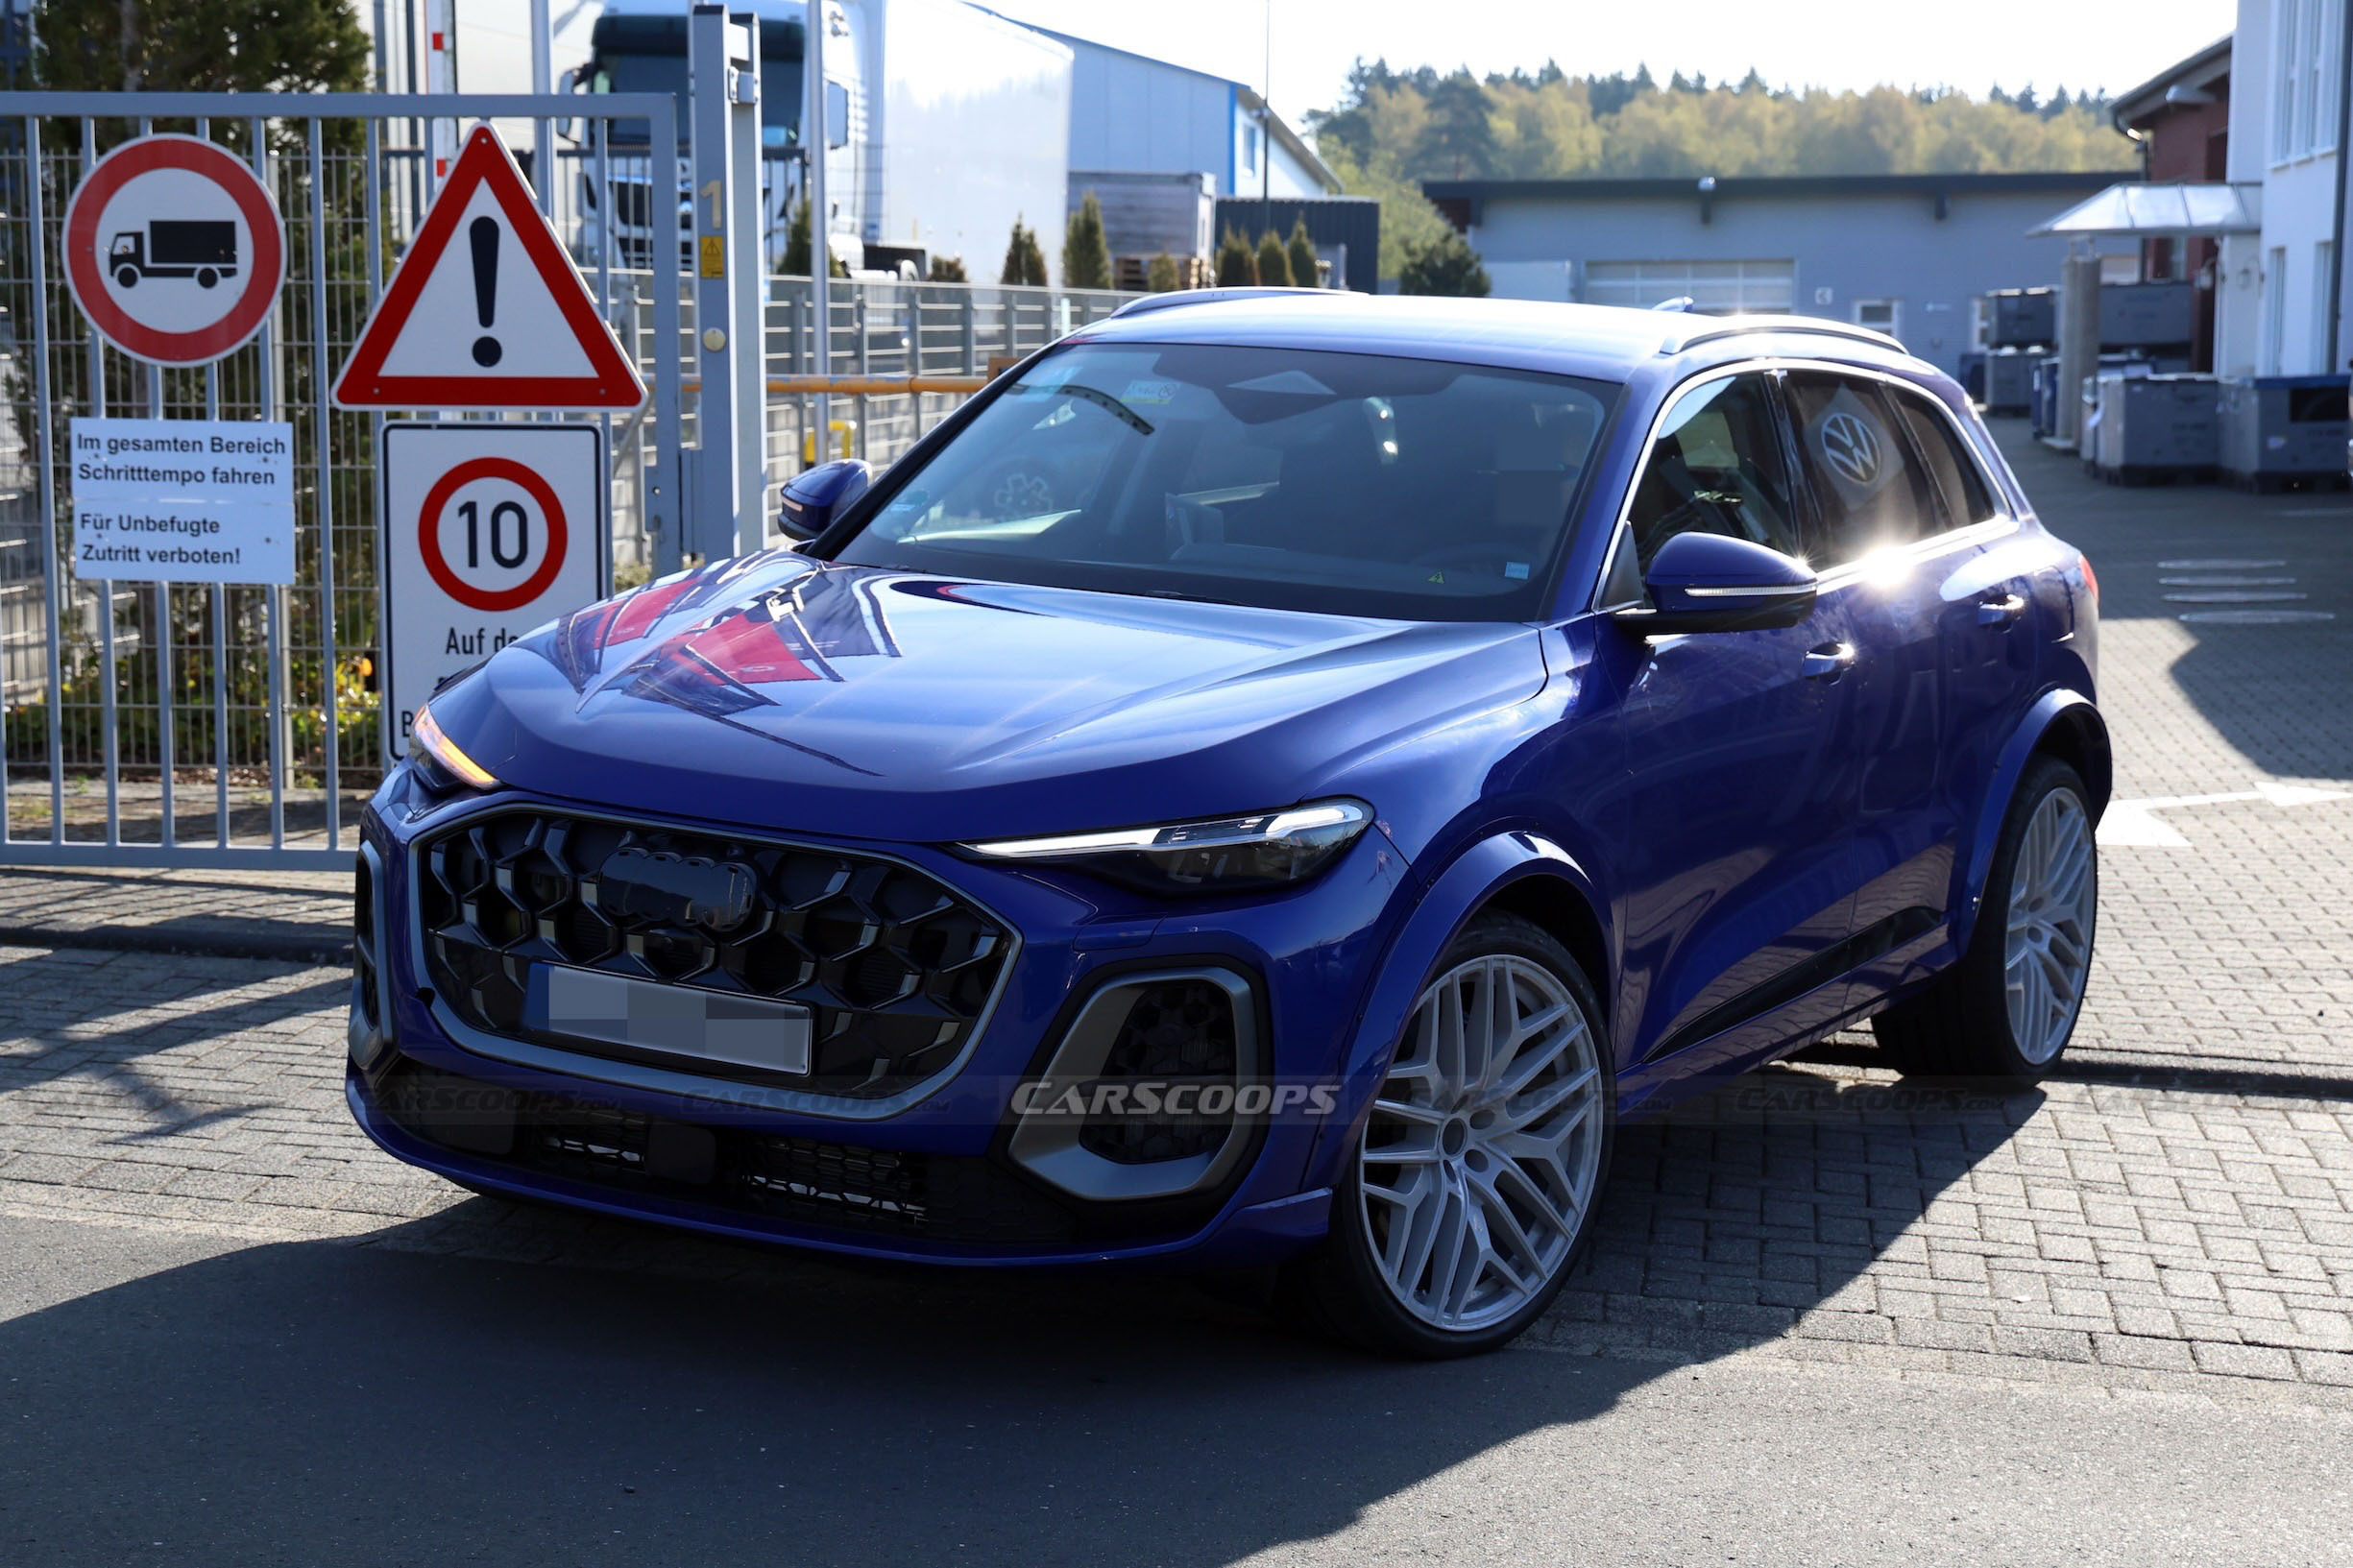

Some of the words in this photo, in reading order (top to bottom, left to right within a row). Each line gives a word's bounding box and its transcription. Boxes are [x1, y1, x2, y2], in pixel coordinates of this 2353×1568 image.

[699, 180, 722, 229] 1
[77, 434, 100, 449] Im
[108, 436, 204, 454] gesamten
[210, 436, 286, 454] Bereich
[79, 463, 206, 486] Schritttempo
[211, 467, 276, 485] fahren
[81, 513, 112, 530] Für
[118, 515, 221, 537] Unbefugte
[458, 500, 528, 569] 10
[82, 544, 141, 562] Zutritt
[146, 546, 241, 565] verboten!
[445, 626, 485, 655] Auf
